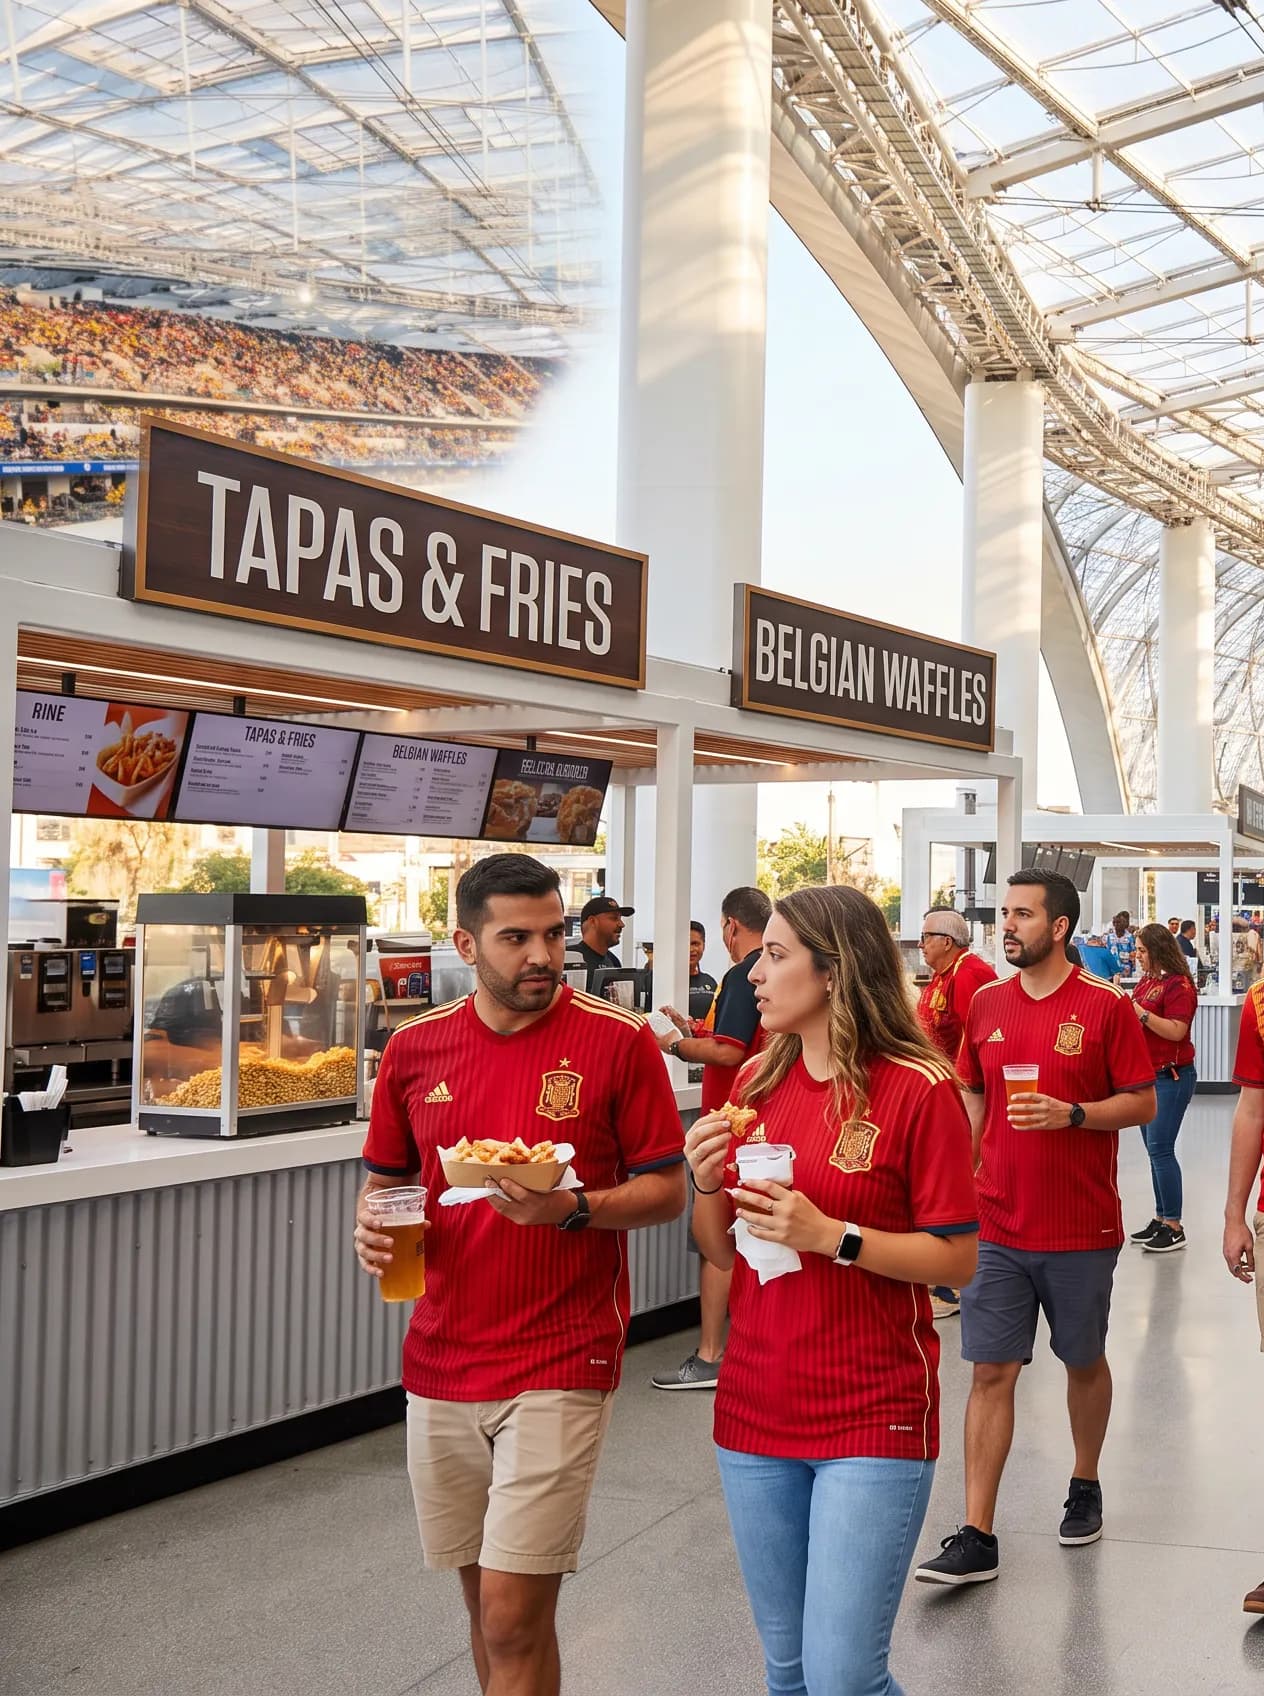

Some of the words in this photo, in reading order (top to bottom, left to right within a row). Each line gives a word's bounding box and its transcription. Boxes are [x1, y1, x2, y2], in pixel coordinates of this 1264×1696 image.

[197, 470, 404, 615] TAPAS
[421, 531, 465, 628] &
[480, 543, 612, 656] FRIES
[755, 618, 875, 704] BELGIAN
[882, 649, 987, 726] WAFFLES
[31, 702, 67, 722] RINE
[245, 726, 277, 745] TAPAS
[278, 730, 288, 745] &
[287, 731, 317, 749] FRIES
[392, 744, 430, 762] BELGIAN
[430, 749, 468, 766] WAFFLES
